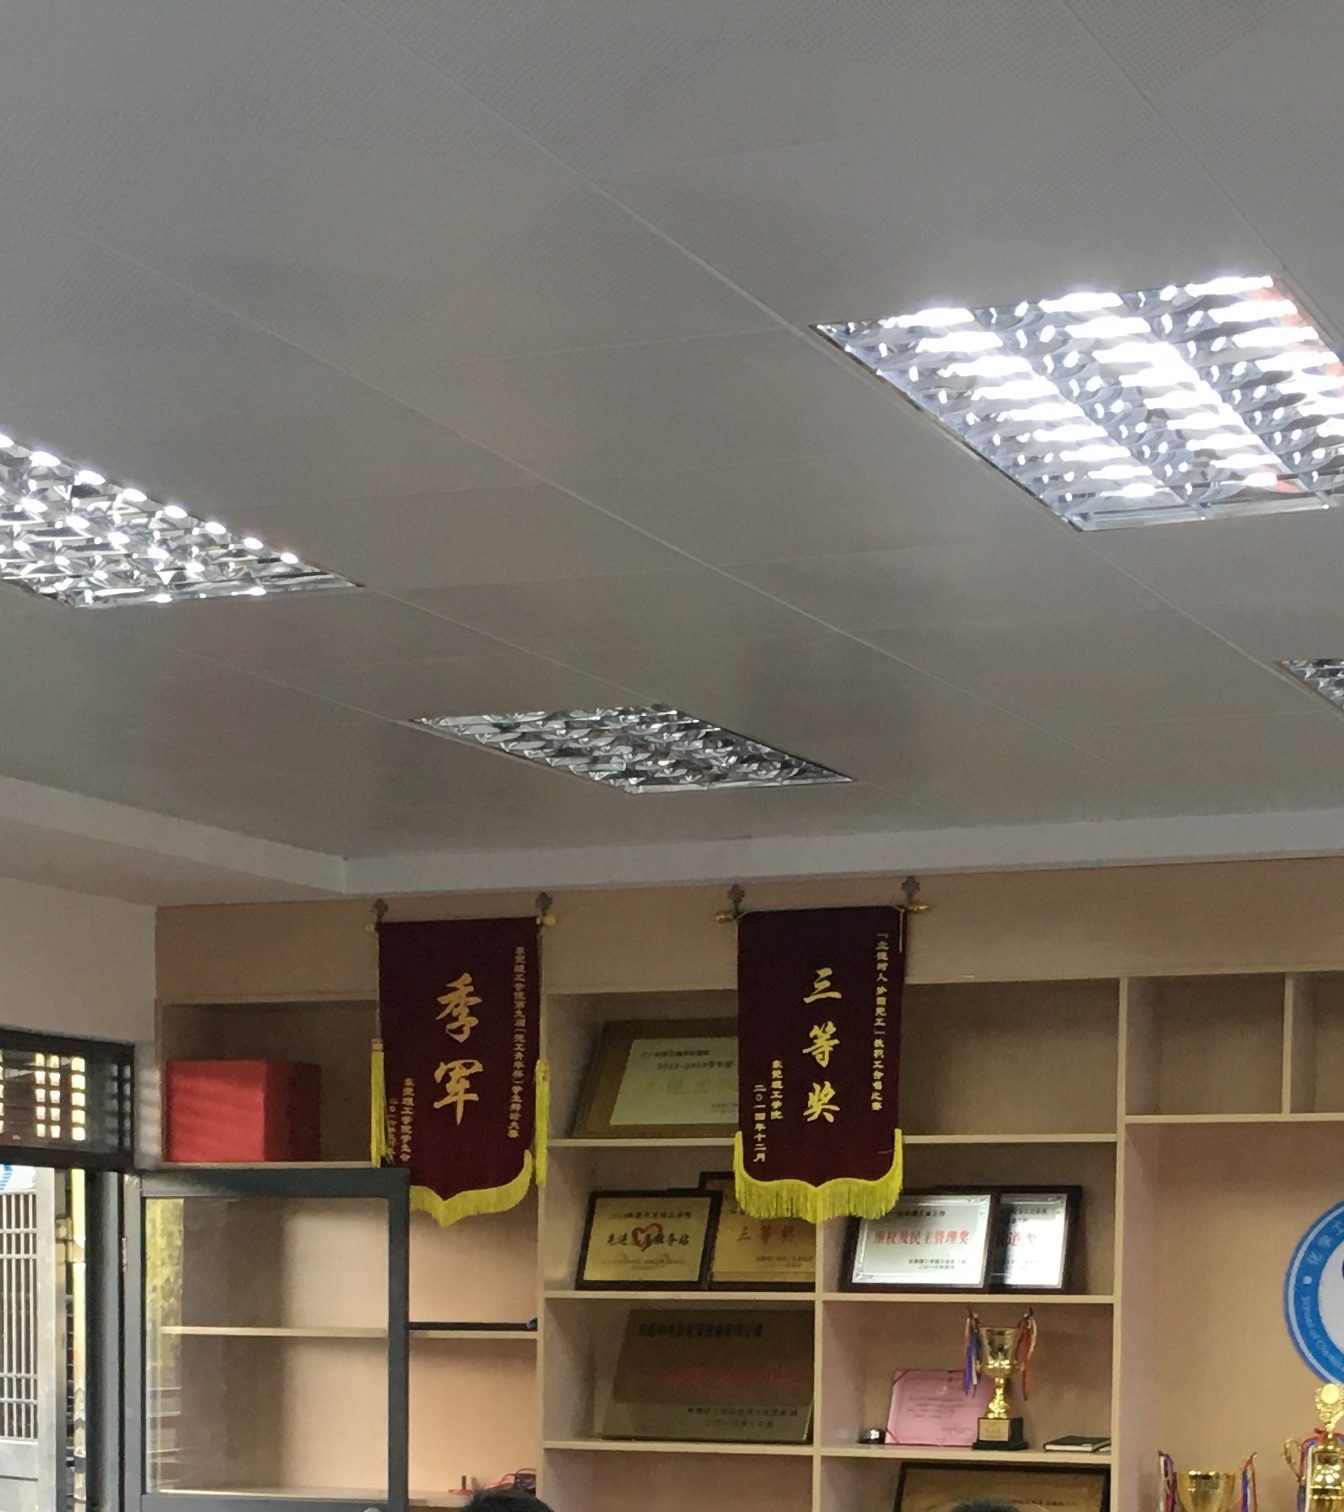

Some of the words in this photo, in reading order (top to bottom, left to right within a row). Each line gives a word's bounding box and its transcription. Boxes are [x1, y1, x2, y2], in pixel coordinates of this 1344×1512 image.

[433, 972, 485, 1126] 季军
[803, 967, 842, 1123] 三等奖
